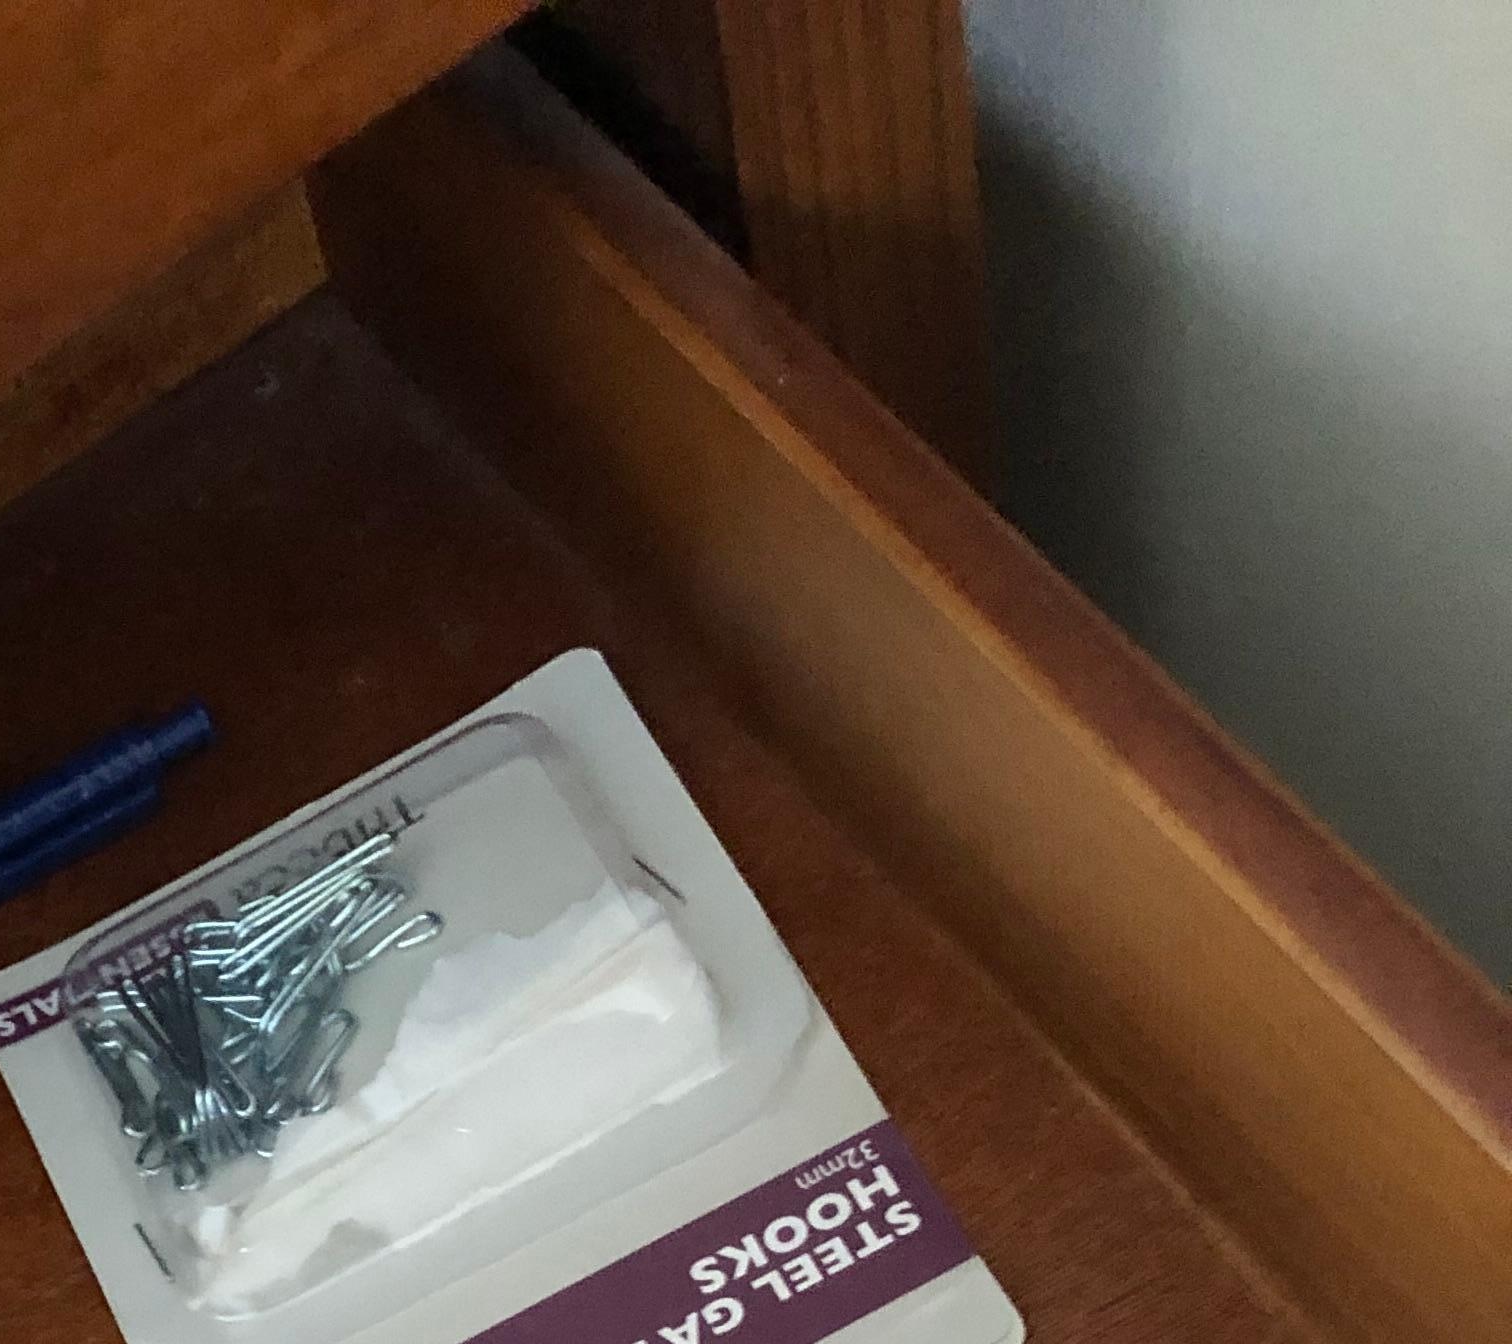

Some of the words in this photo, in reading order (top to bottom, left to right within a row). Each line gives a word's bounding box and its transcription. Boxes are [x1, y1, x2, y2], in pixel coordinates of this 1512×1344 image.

[795, 1139, 880, 1190] 32mm
[689, 1164, 901, 1294] HOOKS
[750, 1200, 922, 1302] STEEL
